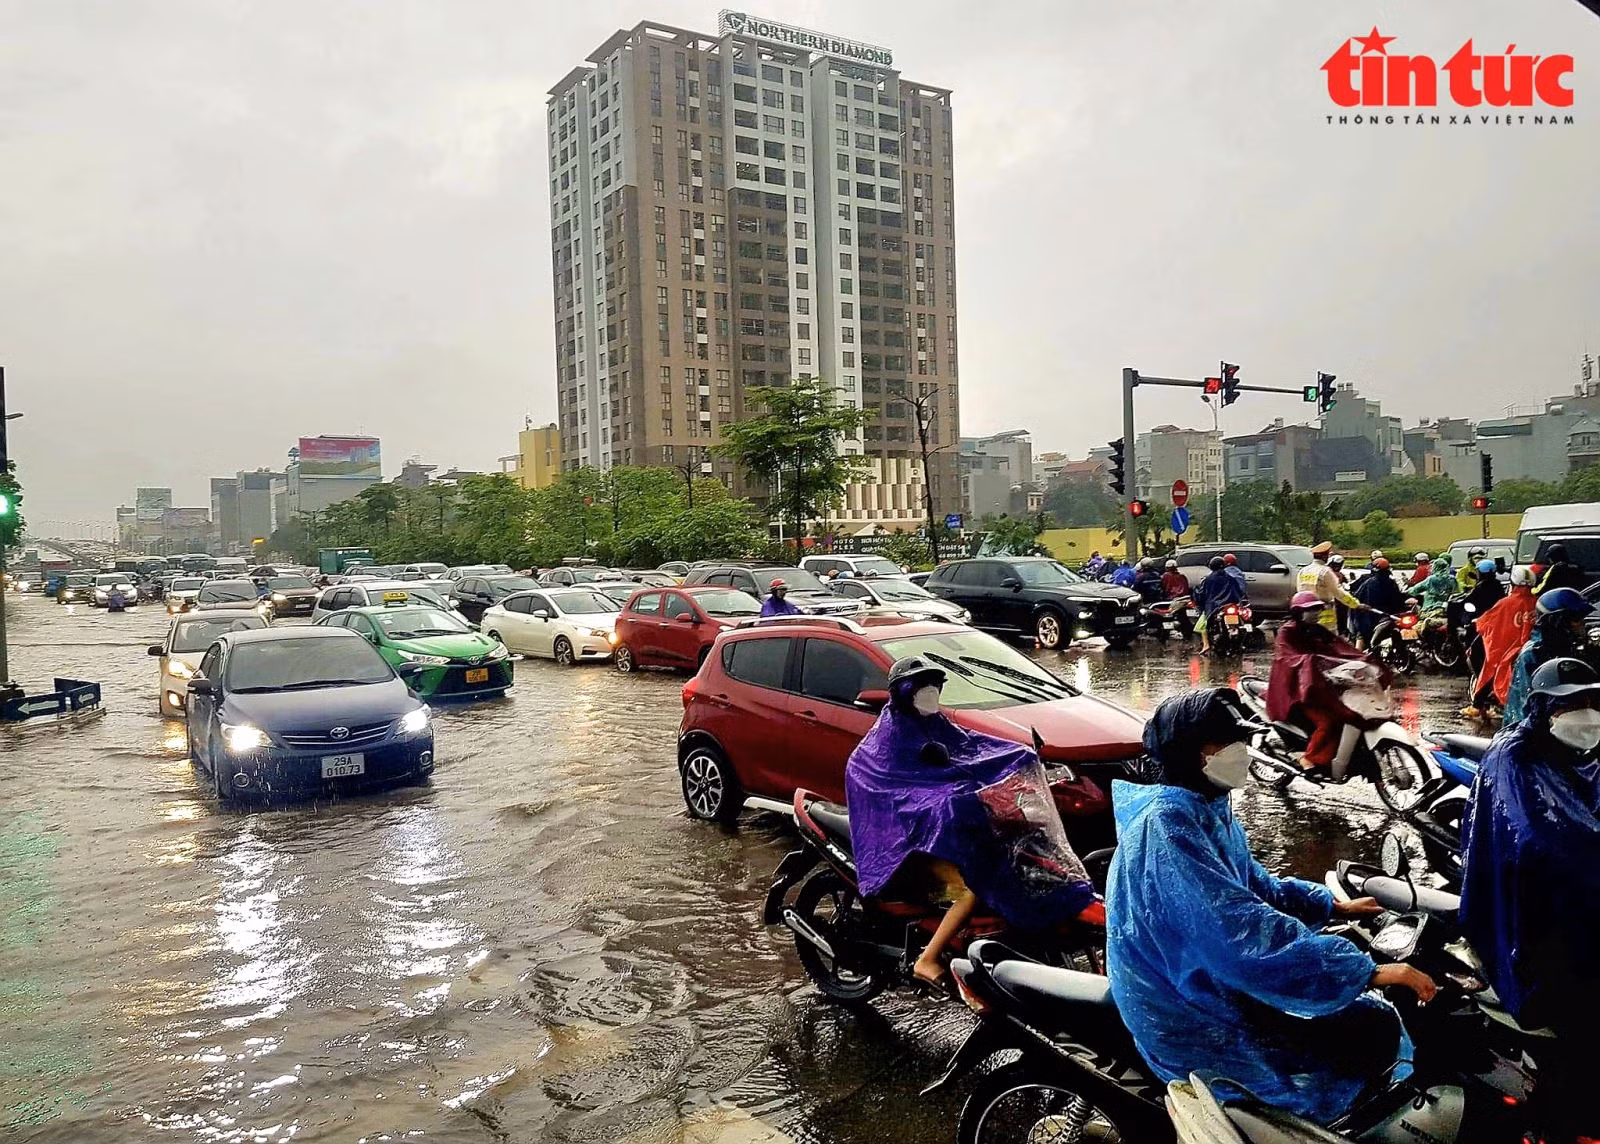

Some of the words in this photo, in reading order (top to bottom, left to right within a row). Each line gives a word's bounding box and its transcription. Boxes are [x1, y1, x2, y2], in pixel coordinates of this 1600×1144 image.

[748, 20, 829, 51] NORTHERN
[831, 41, 893, 66] DIAMOND
[334, 756, 352, 766] 29A
[327, 765, 360, 776] 010.73
